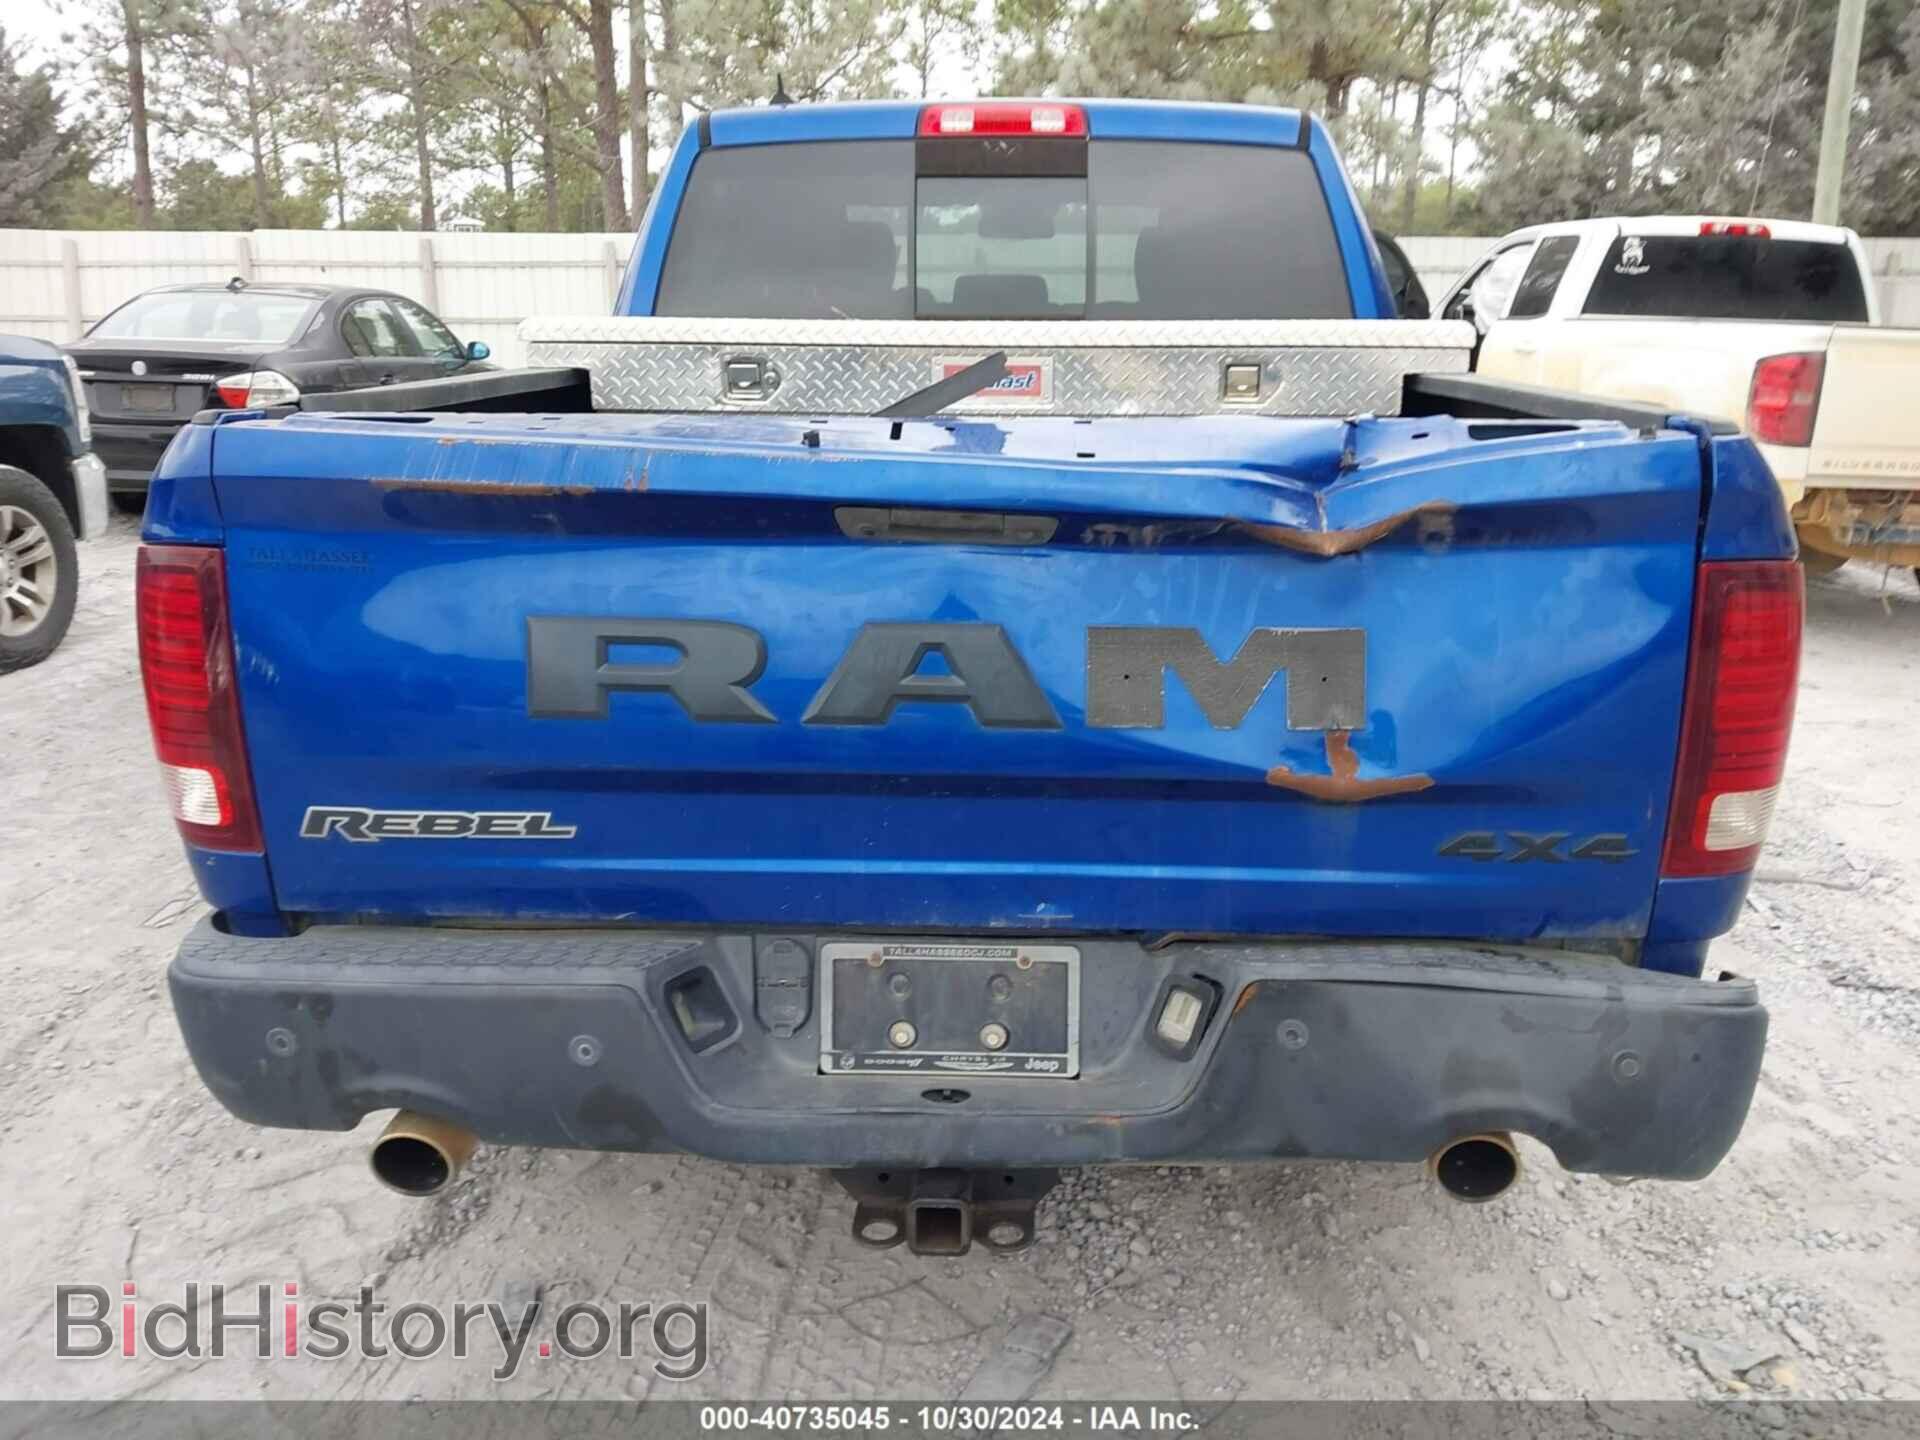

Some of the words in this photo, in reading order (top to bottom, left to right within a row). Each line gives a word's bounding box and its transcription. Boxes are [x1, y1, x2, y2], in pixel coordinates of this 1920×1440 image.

[527, 616, 1365, 730] RAM
[300, 806, 577, 842] REBEL
[1024, 1057, 1059, 1072] Jeep
